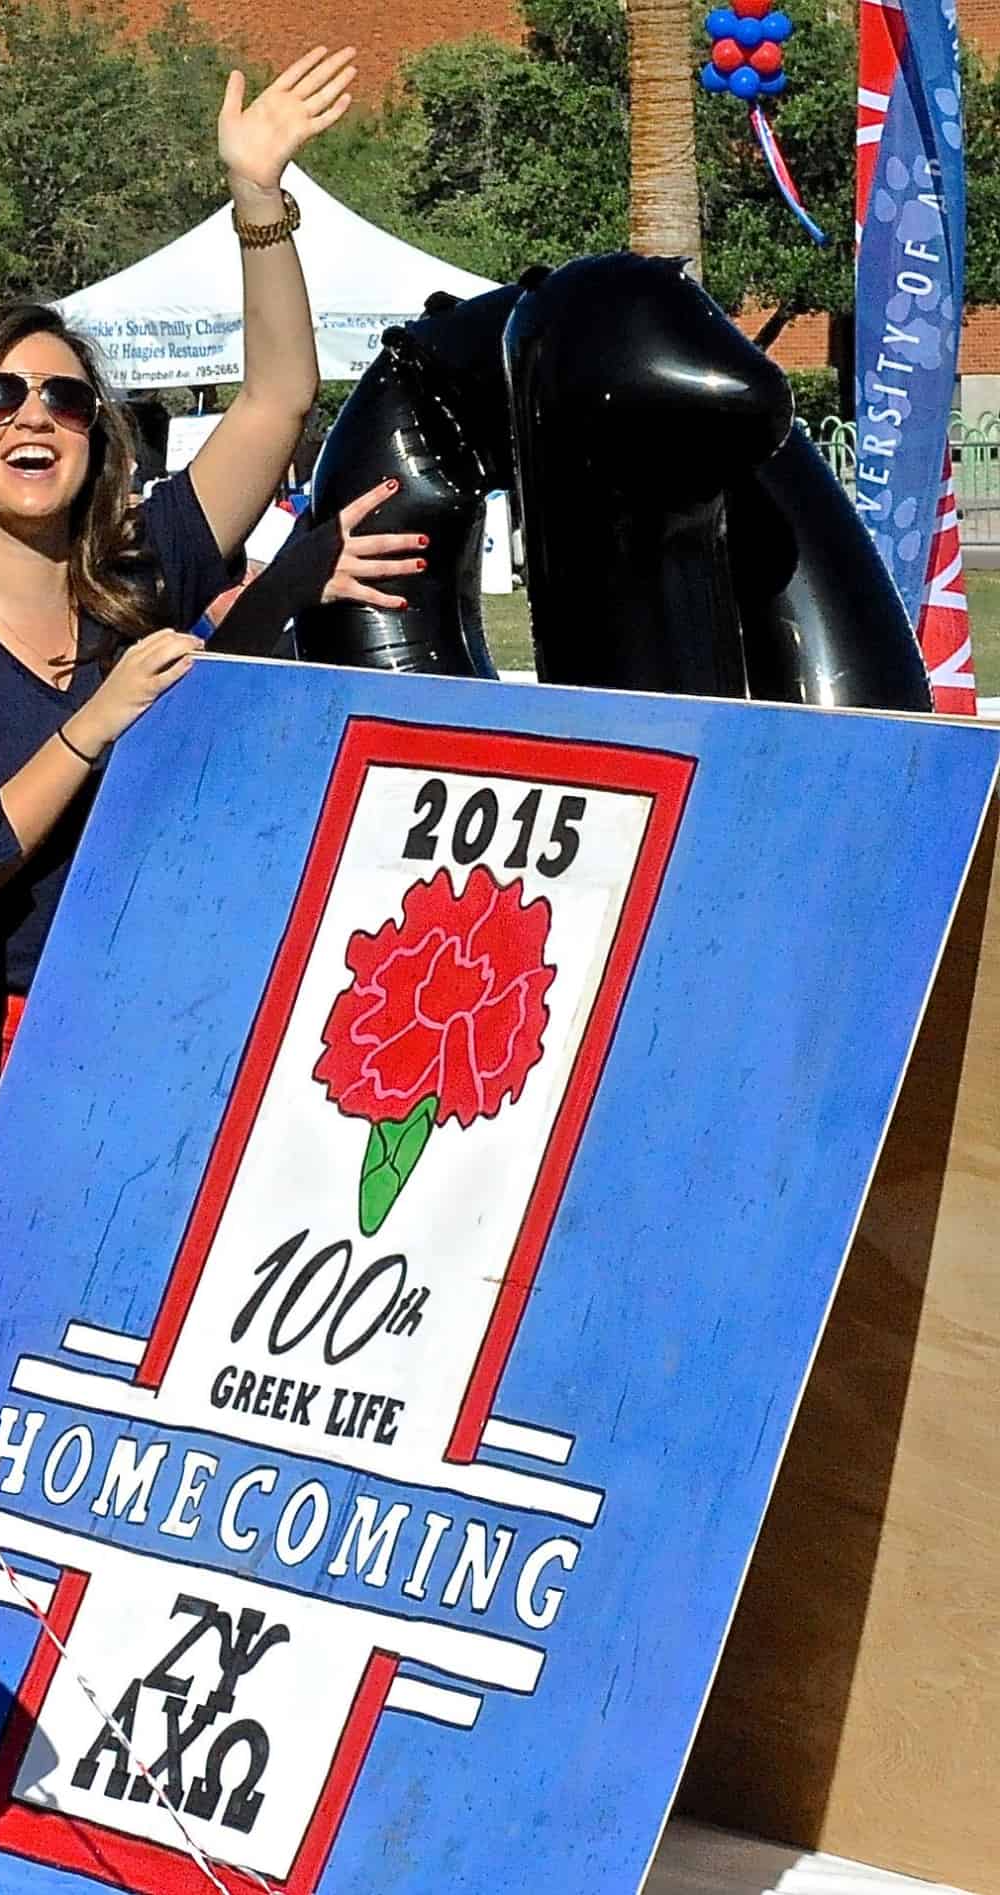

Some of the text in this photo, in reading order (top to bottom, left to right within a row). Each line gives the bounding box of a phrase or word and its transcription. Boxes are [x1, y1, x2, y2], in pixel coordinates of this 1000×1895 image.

[160, 319, 193, 340] Philly
[856, 322, 921, 513] VERSITY
[896, 239, 940, 298] OF
[401, 778, 587, 879] 2015
[230, 1228, 431, 1366] 100th
[210, 1365, 406, 1446] GREEK LIFE
